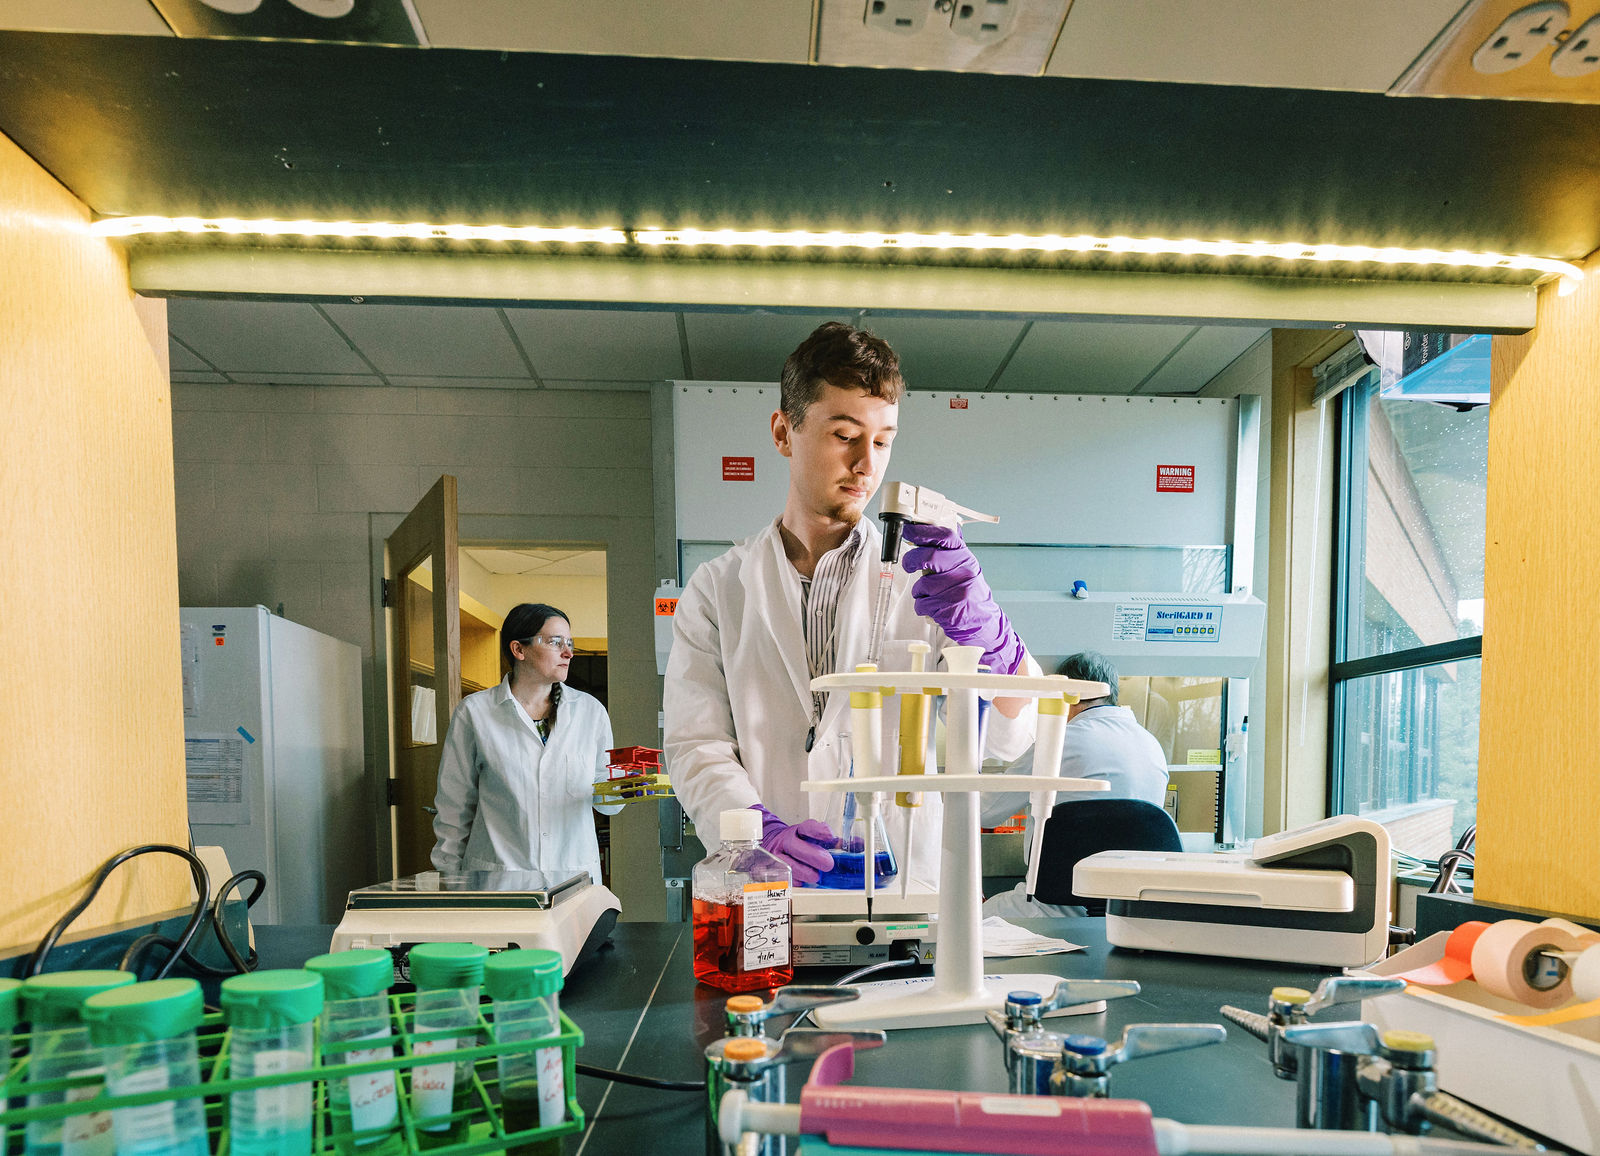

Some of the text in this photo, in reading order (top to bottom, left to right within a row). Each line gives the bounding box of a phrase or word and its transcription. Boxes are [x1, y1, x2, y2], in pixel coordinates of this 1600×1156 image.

[1420, 333, 1429, 365] Powder
[1159, 467, 1192, 476] WARNING
[1156, 611, 1203, 620] SterilGARD
